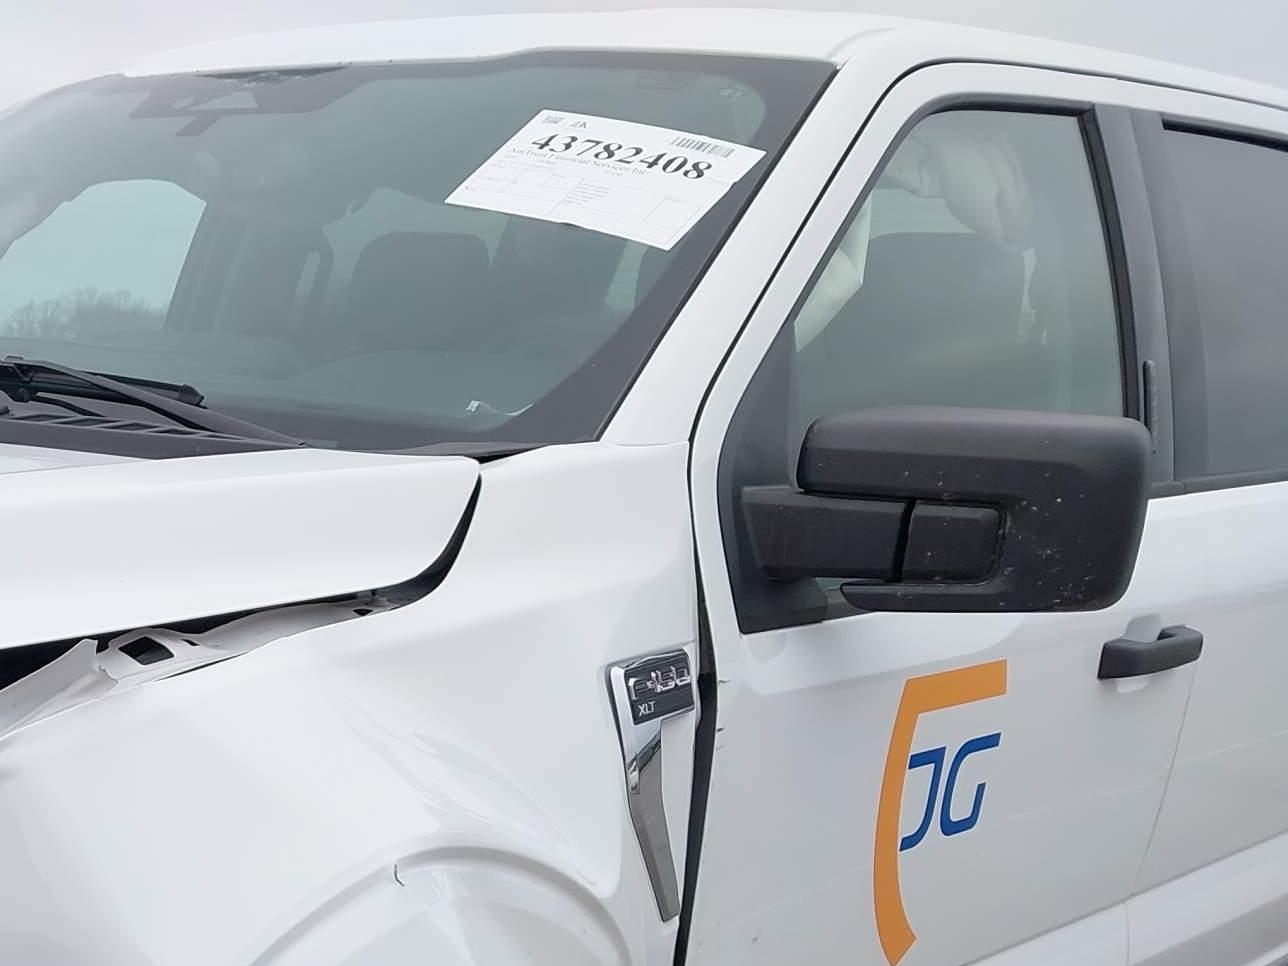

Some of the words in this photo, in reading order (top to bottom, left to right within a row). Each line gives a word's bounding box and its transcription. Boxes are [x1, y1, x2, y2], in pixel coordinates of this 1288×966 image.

[531, 133, 713, 180] 43782408
[638, 701, 656, 718] XLT
[898, 731, 1002, 853] JG
